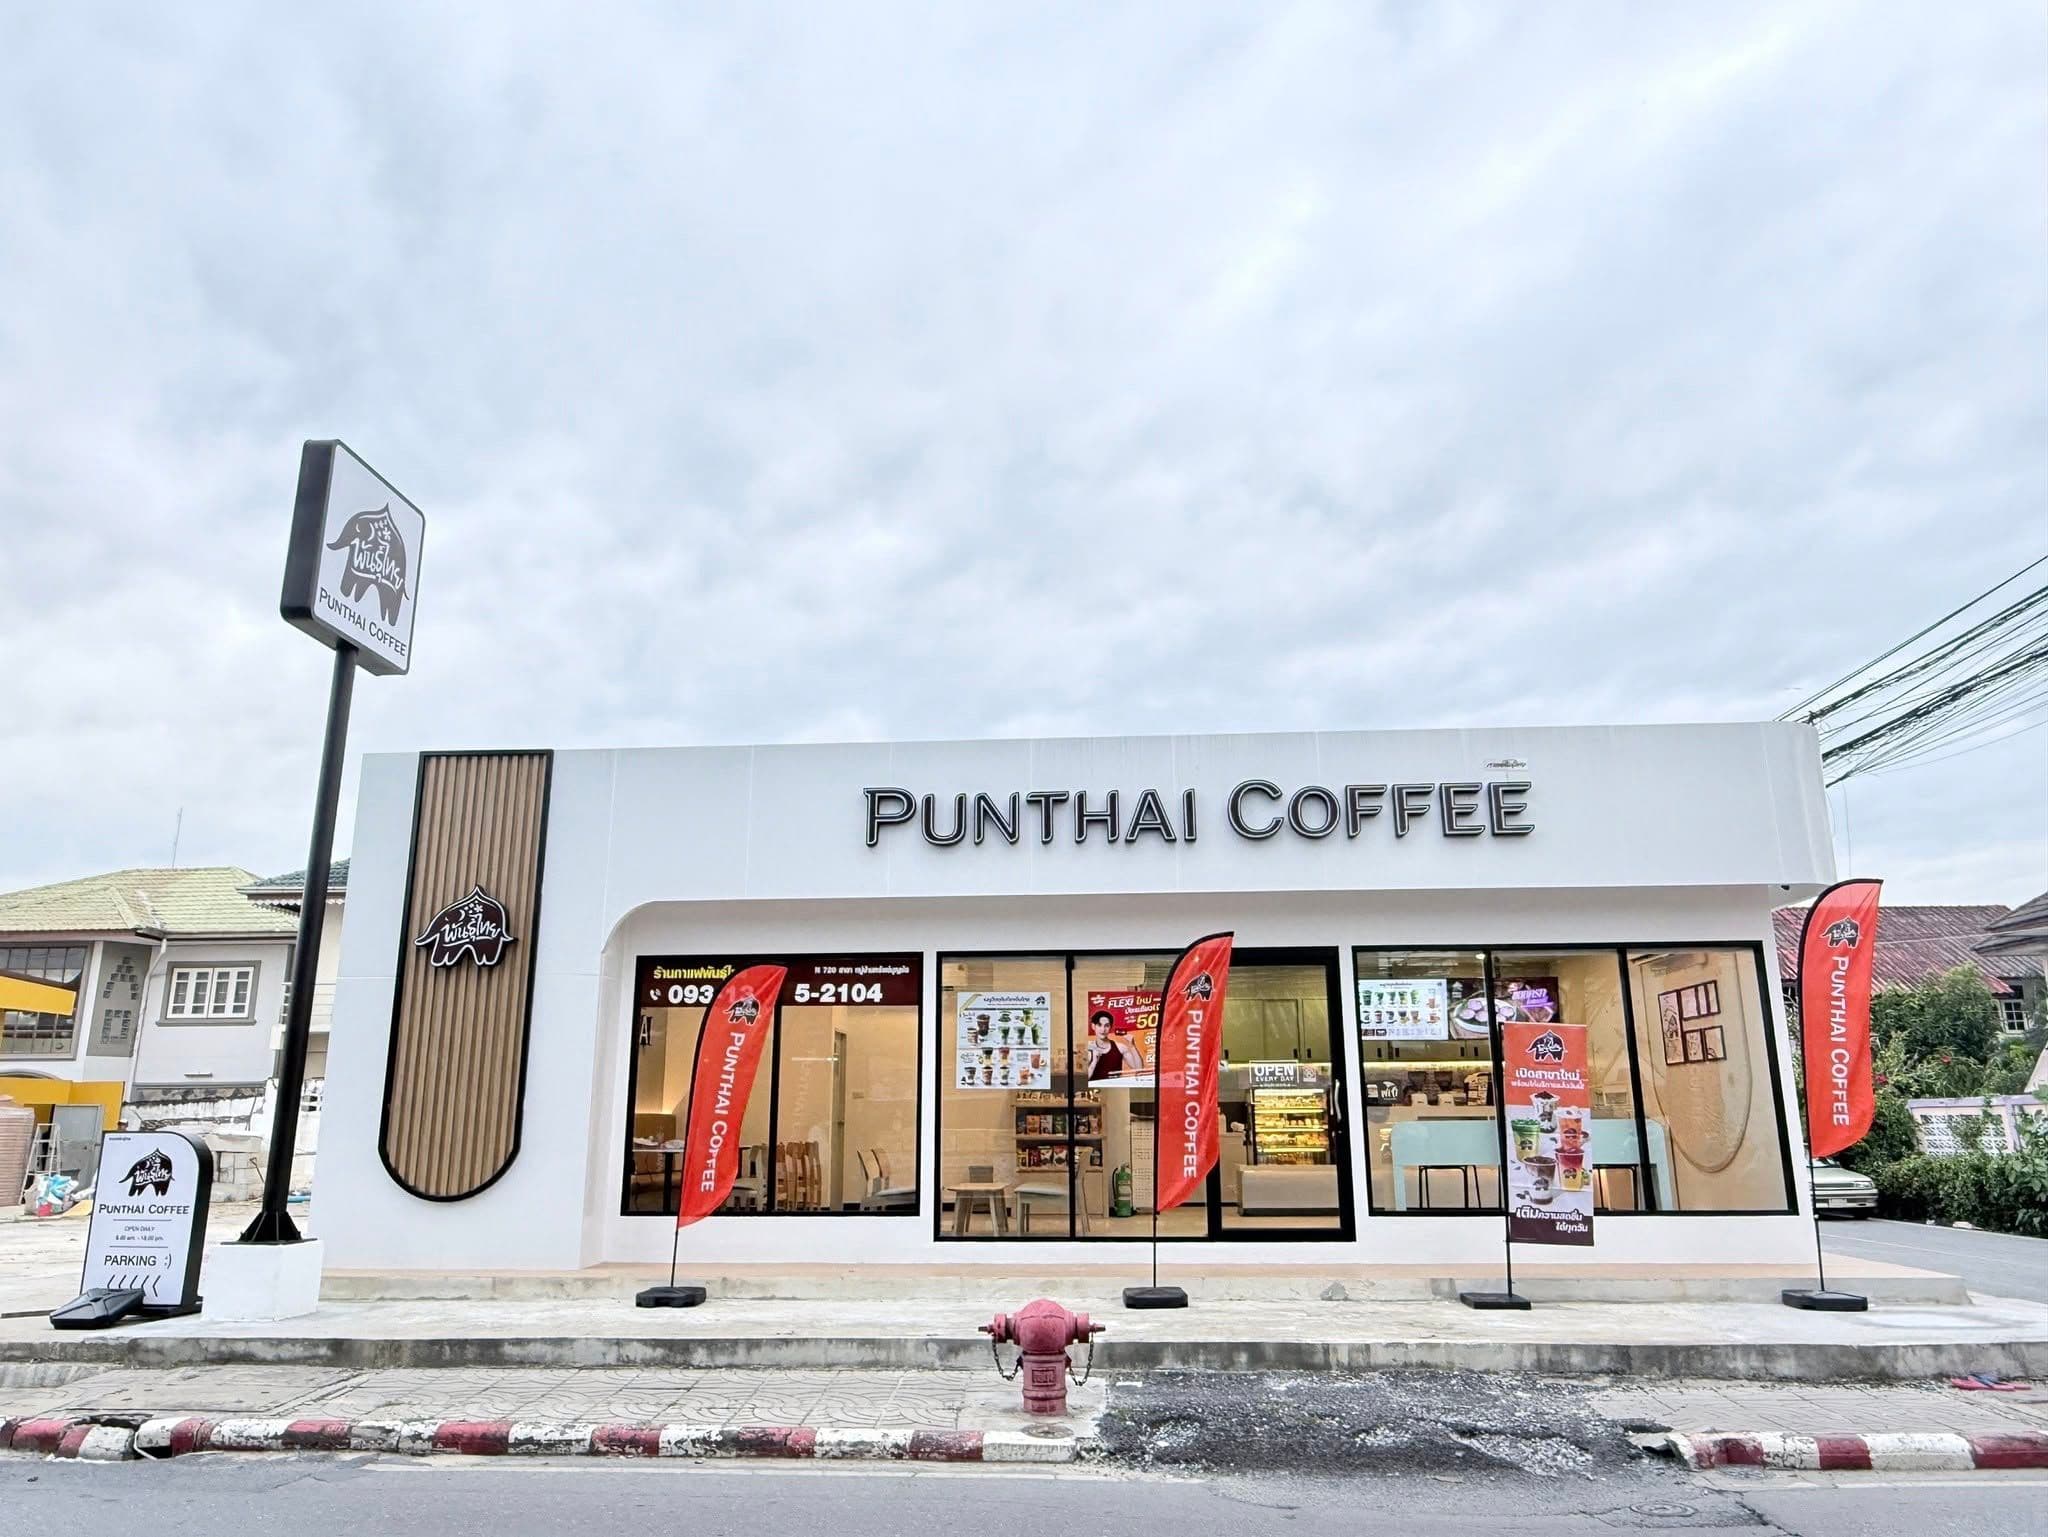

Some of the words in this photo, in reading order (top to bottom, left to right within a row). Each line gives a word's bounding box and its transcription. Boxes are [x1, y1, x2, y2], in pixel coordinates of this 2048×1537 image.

[319, 587, 367, 632] PUNTHAI
[368, 621, 408, 657] COFFEE
[863, 787, 1197, 846] PUNTHAI
[1227, 779, 1535, 840] COFFEE
[1830, 956, 1849, 1042] PUNTHAI
[713, 1031, 746, 1115] PUNTHAI
[1185, 1009, 1203, 1096] PUNTHAI
[1254, 1063, 1294, 1076] OPEN
[1831, 1049, 1850, 1126] COFFEE
[701, 1122, 728, 1192] COFFEE
[1183, 1101, 1200, 1178] COFFEE
[99, 1204, 145, 1214] PUNTHAI
[148, 1204, 190, 1214] COFFEE
[104, 1255, 157, 1267] PARKING
